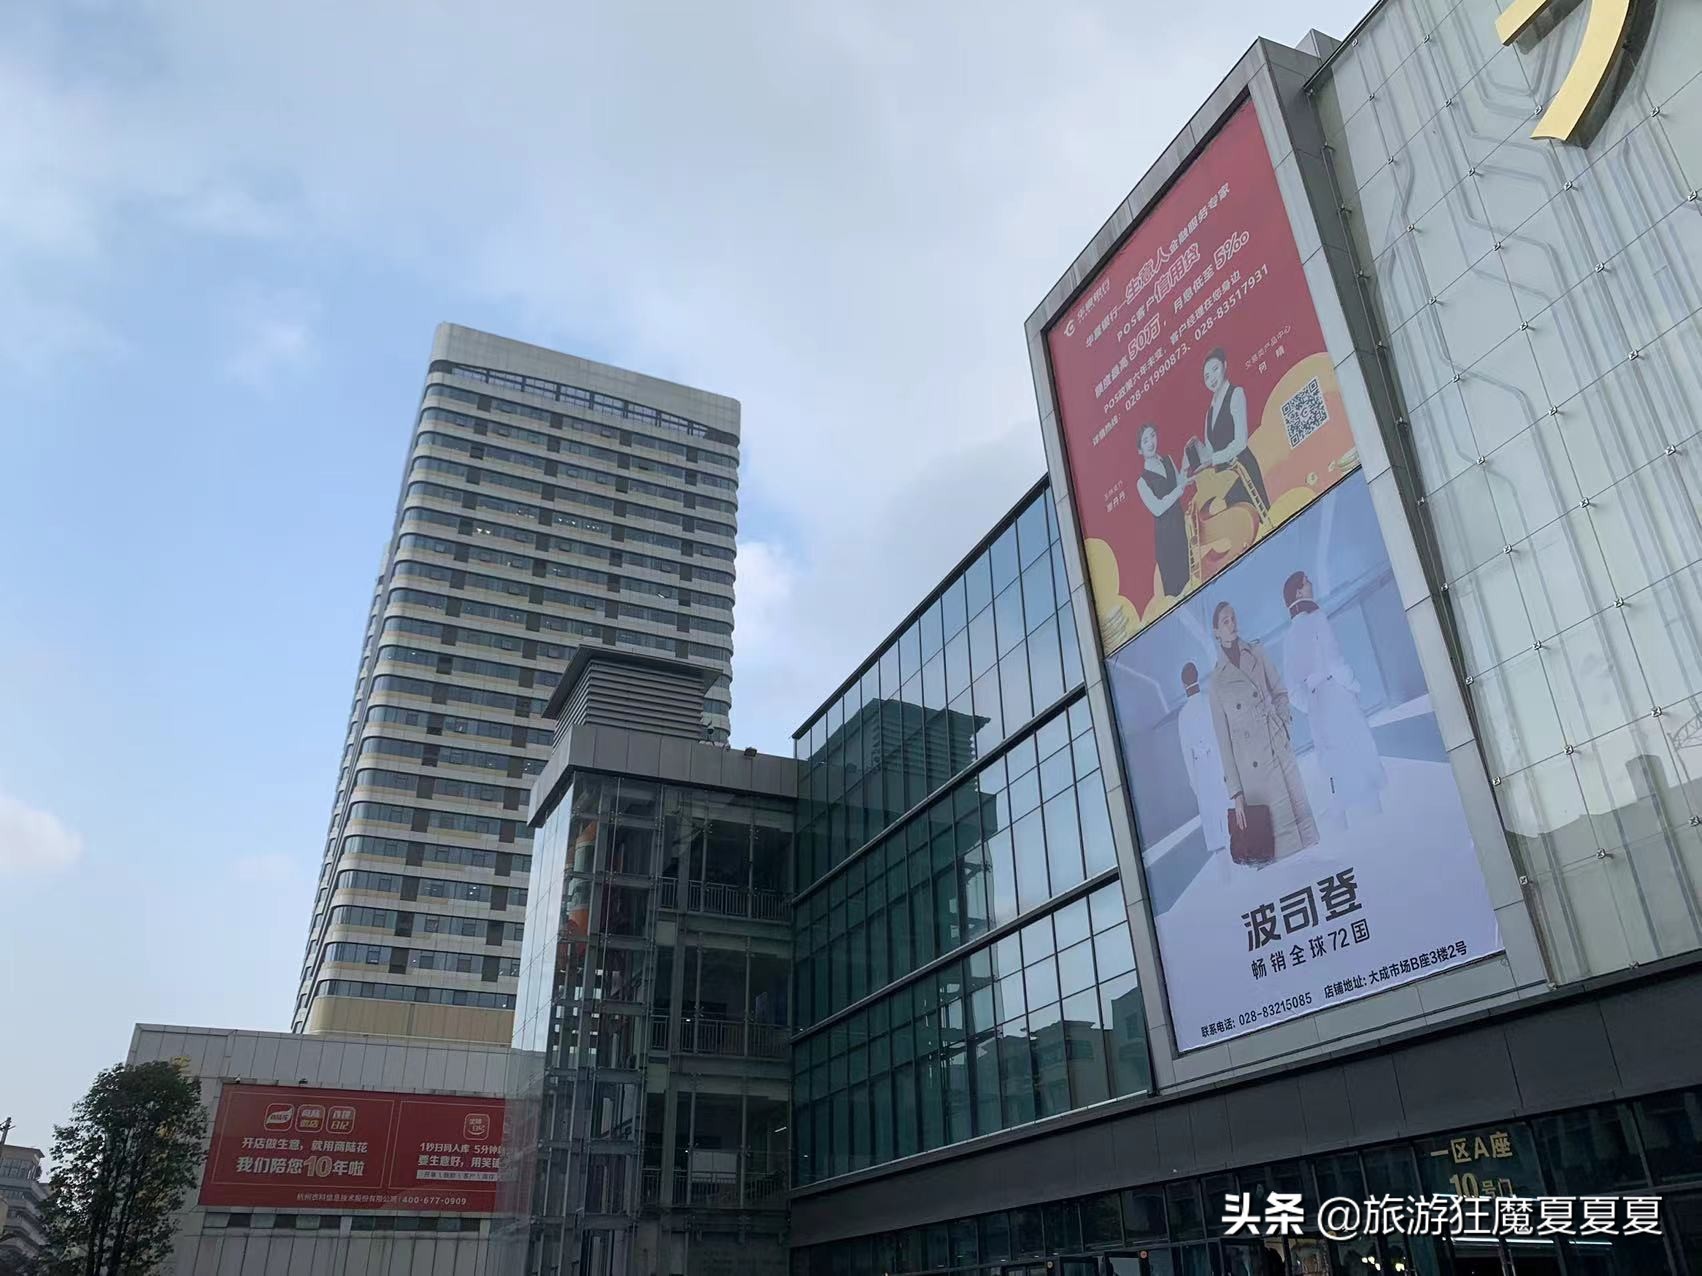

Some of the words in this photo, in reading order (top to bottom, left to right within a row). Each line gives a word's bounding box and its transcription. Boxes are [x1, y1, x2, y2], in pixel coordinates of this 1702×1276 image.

[1241, 867, 1362, 951] 波司登
[1251, 919, 1370, 980] 畅销全球72国
[237, 1156, 364, 1177] 我们陪您10年啦
[1430, 1132, 1512, 1163] 一区A座
